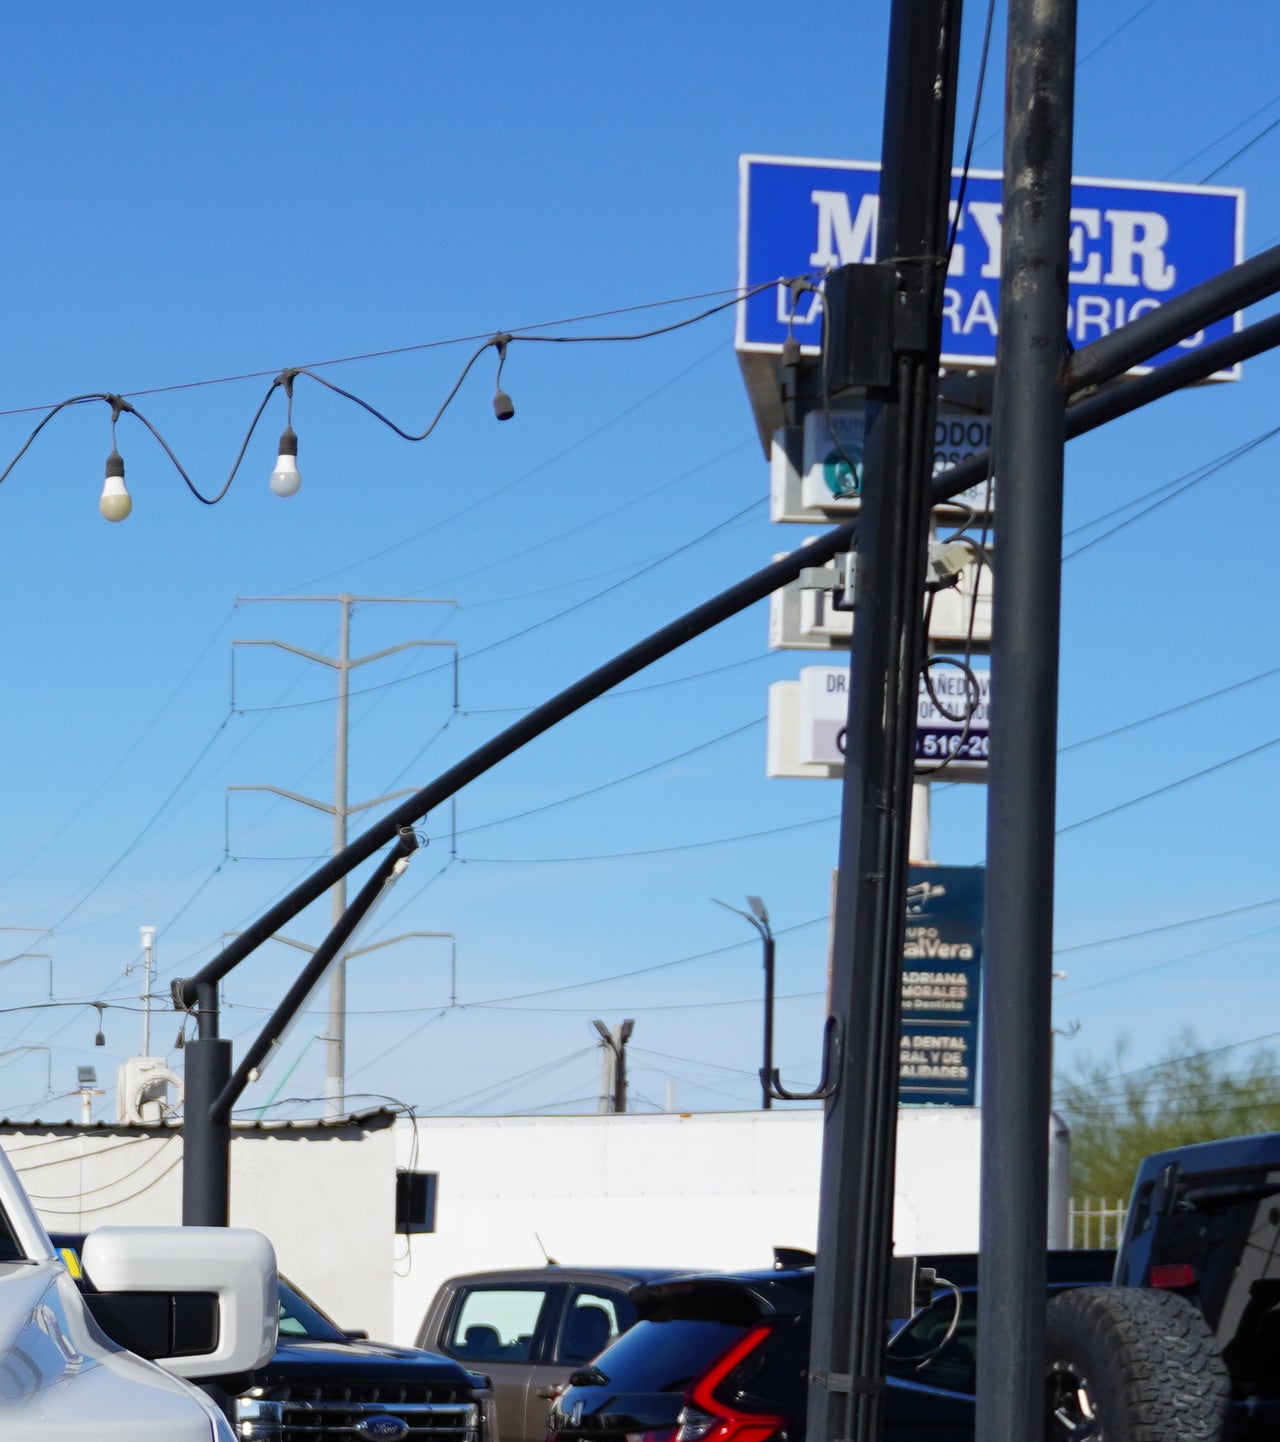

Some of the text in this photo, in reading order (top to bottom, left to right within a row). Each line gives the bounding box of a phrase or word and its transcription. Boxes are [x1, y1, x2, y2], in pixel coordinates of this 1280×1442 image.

[809, 190, 1176, 291] MYER
[905, 926, 938, 938] UPO
[901, 985, 968, 999] MORALES
[912, 1035, 967, 1051] DENTAL
[931, 1051, 941, 1064] Y
[942, 1051, 962, 1065] DE
